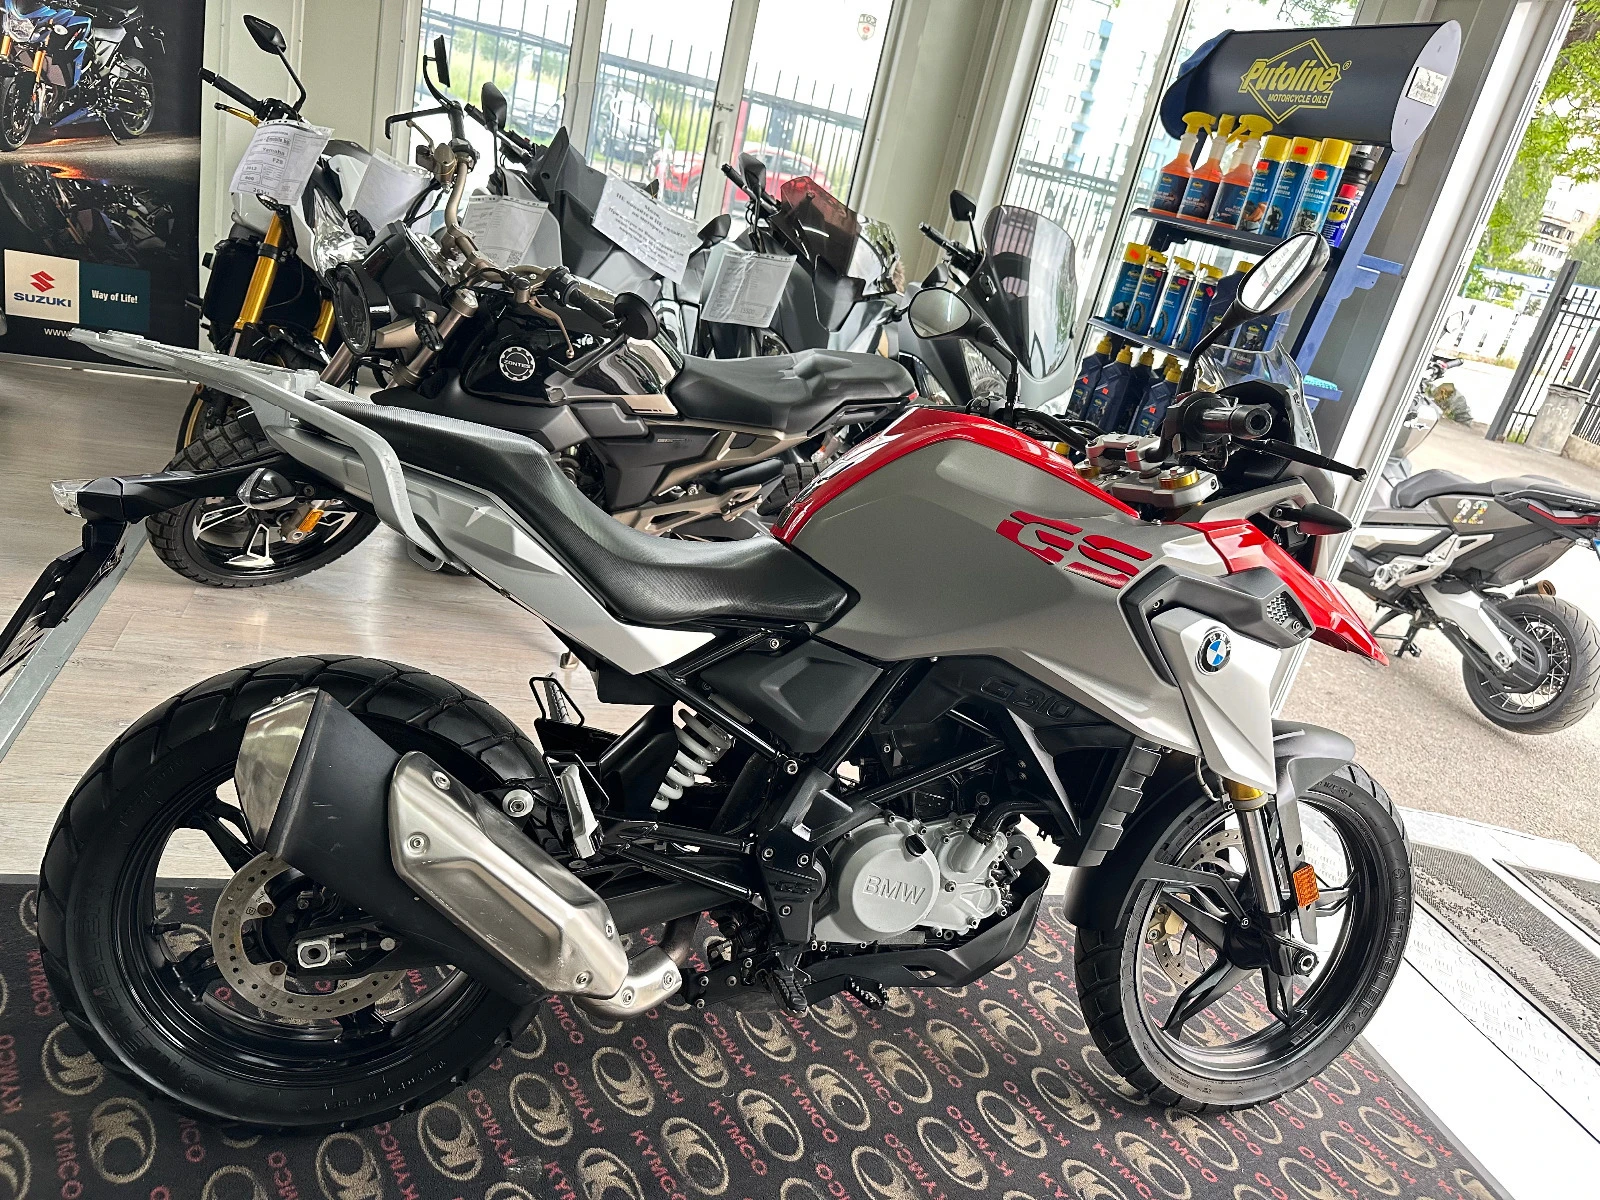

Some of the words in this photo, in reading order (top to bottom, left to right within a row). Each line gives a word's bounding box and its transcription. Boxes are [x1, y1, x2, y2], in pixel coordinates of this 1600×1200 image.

[1243, 60, 1338, 93] Putoline
[1267, 92, 1312, 104] MOTORCYCLE
[1311, 94, 1328, 105] OILS
[13, 292, 72, 308] SUZUKI
[91, 289, 108, 303] Way
[110, 292, 119, 301] of
[120, 293, 138, 304] Life!
[1453, 499, 1489, 525] 22
[995, 510, 1153, 589] GS
[862, 873, 926, 906] BMW
[1356, 884, 1408, 1020] METZELER
[549, 994, 585, 1045] YMCO
[703, 1012, 757, 1077] KYMCO
[957, 1007, 1018, 1065] KYMCO
[1007, 988, 1069, 1044] KYMCO
[632, 1036, 684, 1104] KYMCO
[843, 1050, 904, 1115] KYMCO
[904, 1028, 964, 1089] KYMCO
[1055, 1057, 1122, 1119] KYMCO
[467, 1088, 519, 1167] KYMCO
[553, 1061, 605, 1135] KYMCO
[779, 1073, 839, 1144] KYMCO
[1003, 1080, 1071, 1148] KYMCO
[1375, 1097, 1453, 1158] KYMCO
[52, 1110, 84, 1199] KYMCO
[708, 1100, 768, 1176] KYMCO
[946, 1105, 1016, 1177] KYMCO
[1145, 1116, 1218, 1183] KYMCO
[1338, 1120, 1417, 1185] KYMCO
[1093, 1142, 1159, 1200] KYMC
[1298, 1145, 1361, 1200] YMCO
